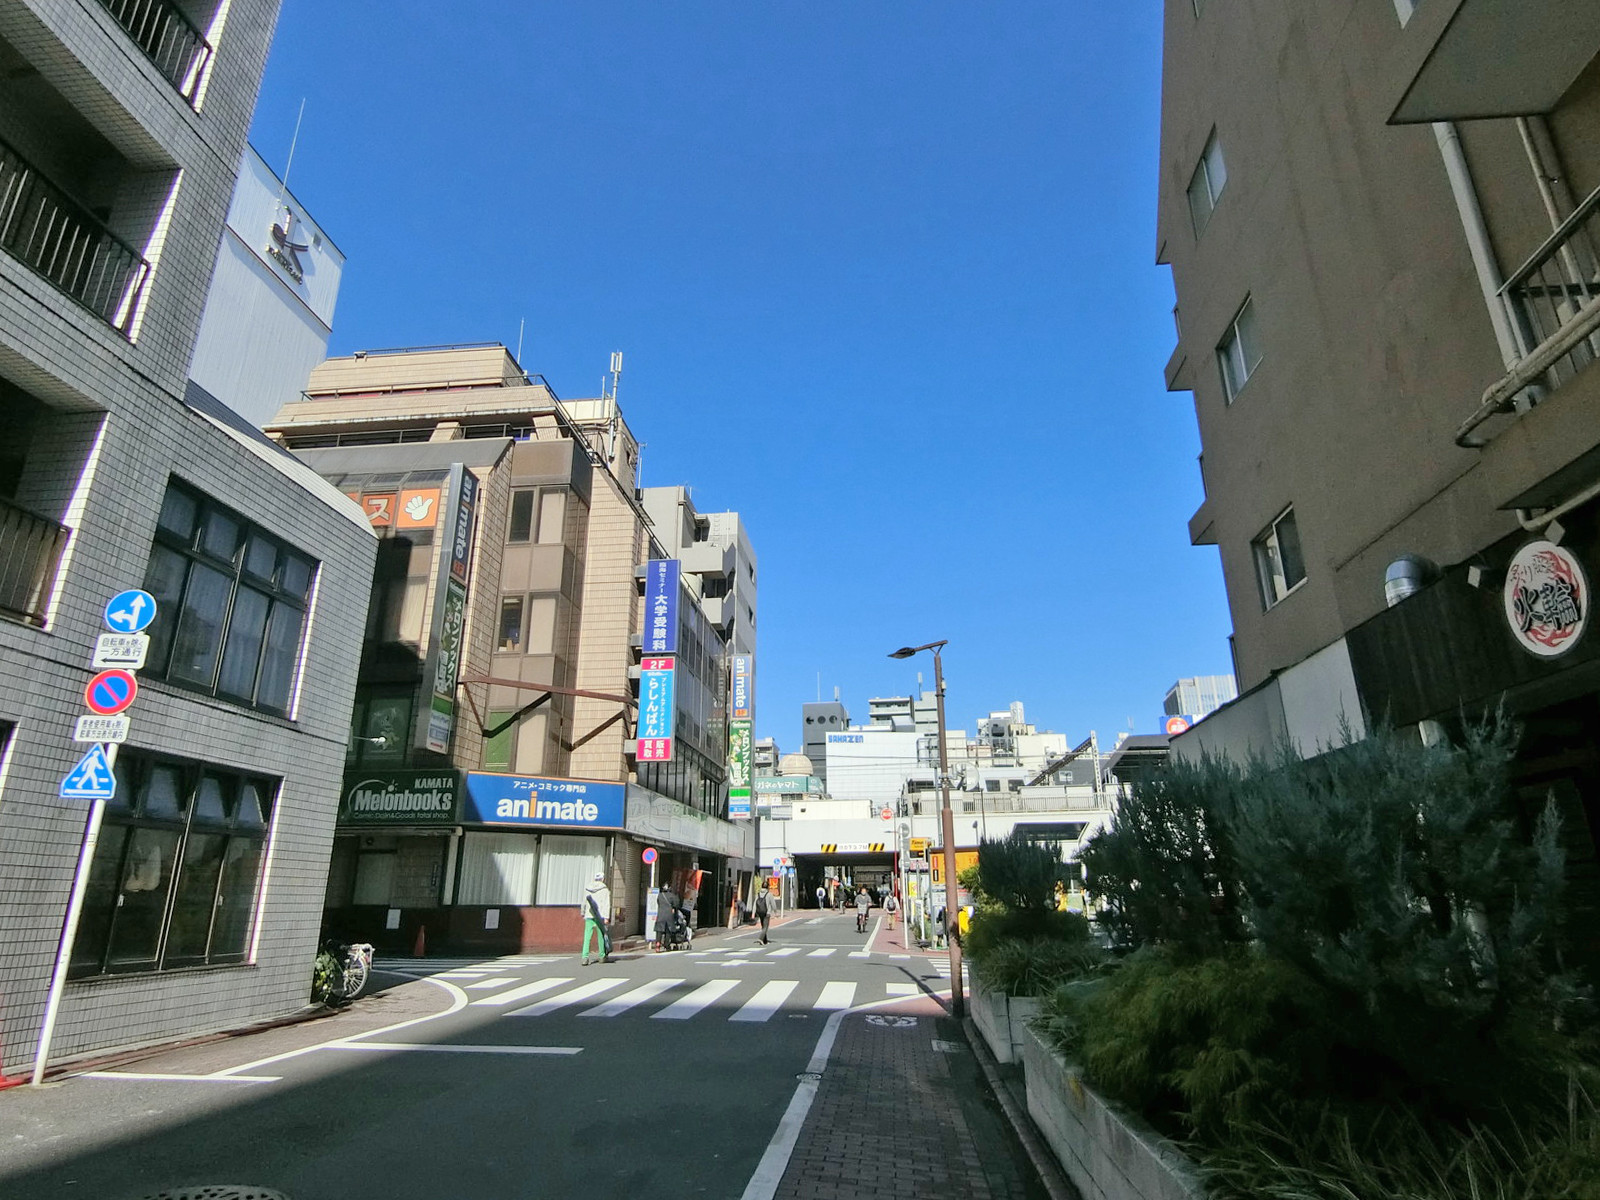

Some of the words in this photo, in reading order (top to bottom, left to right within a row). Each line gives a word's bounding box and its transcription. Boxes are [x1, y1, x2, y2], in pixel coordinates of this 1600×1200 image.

[455, 475, 473, 559] animate
[652, 594, 668, 650] 大学受験科
[100, 647, 142, 656] 一方通行
[102, 637, 144, 647] 自転車を除く
[446, 600, 462, 688] メロンブックス
[650, 660, 665, 669] 2F
[736, 658, 749, 708] animate
[645, 677, 659, 736] らしんばん
[742, 729, 750, 781] メロンブックス
[414, 778, 453, 788] KAMATA
[513, 780, 587, 793] アニメ・コミック専門店
[354, 789, 452, 811] Melonbooks
[496, 791, 598, 821] animate
